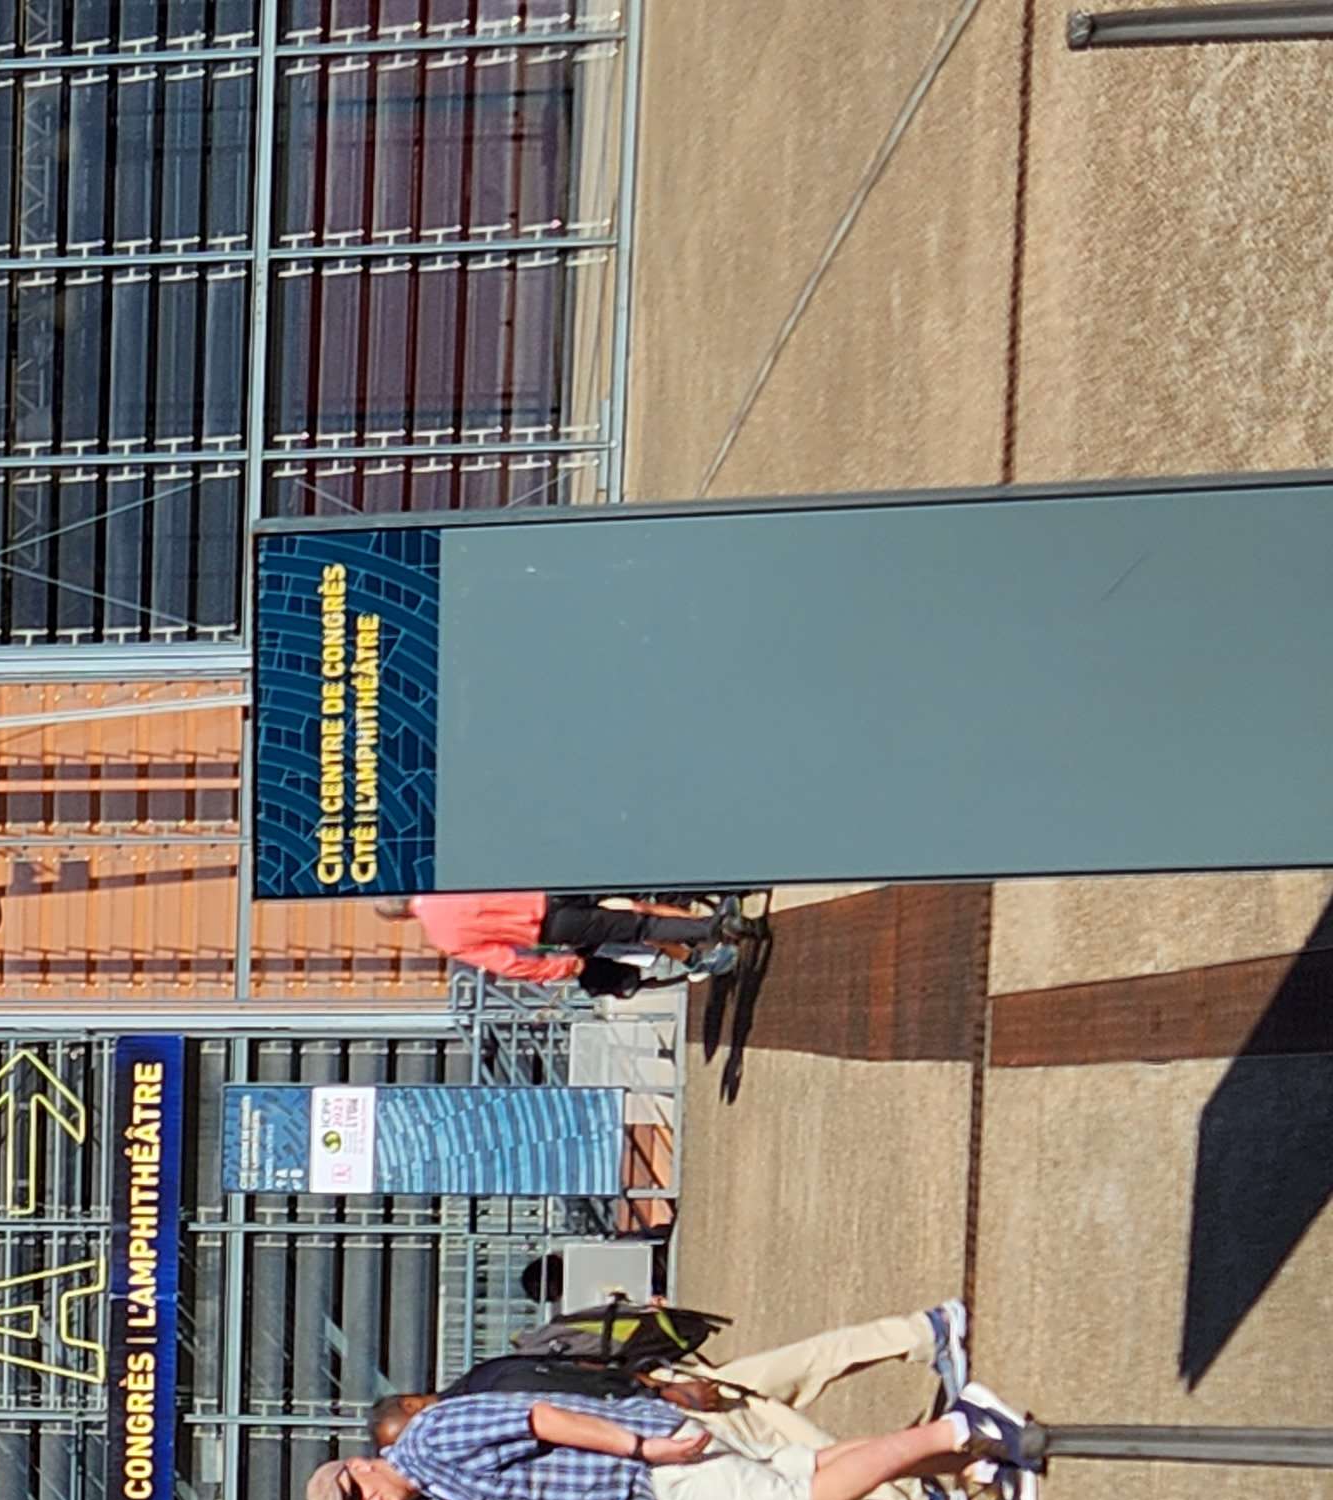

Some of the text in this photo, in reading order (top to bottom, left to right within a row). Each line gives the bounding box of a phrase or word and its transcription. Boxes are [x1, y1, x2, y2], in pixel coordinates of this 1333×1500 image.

[317, 564, 347, 677] CONGRÈS
[321, 681, 346, 714] DE
[349, 613, 381, 810] L'AMPHITHÉÂTRE
[320, 718, 345, 813] CENTRE
[123, 1062, 163, 1328] L'AMPHITHÉÂTRE
[118, 1352, 156, 1500] CONGRÈS
